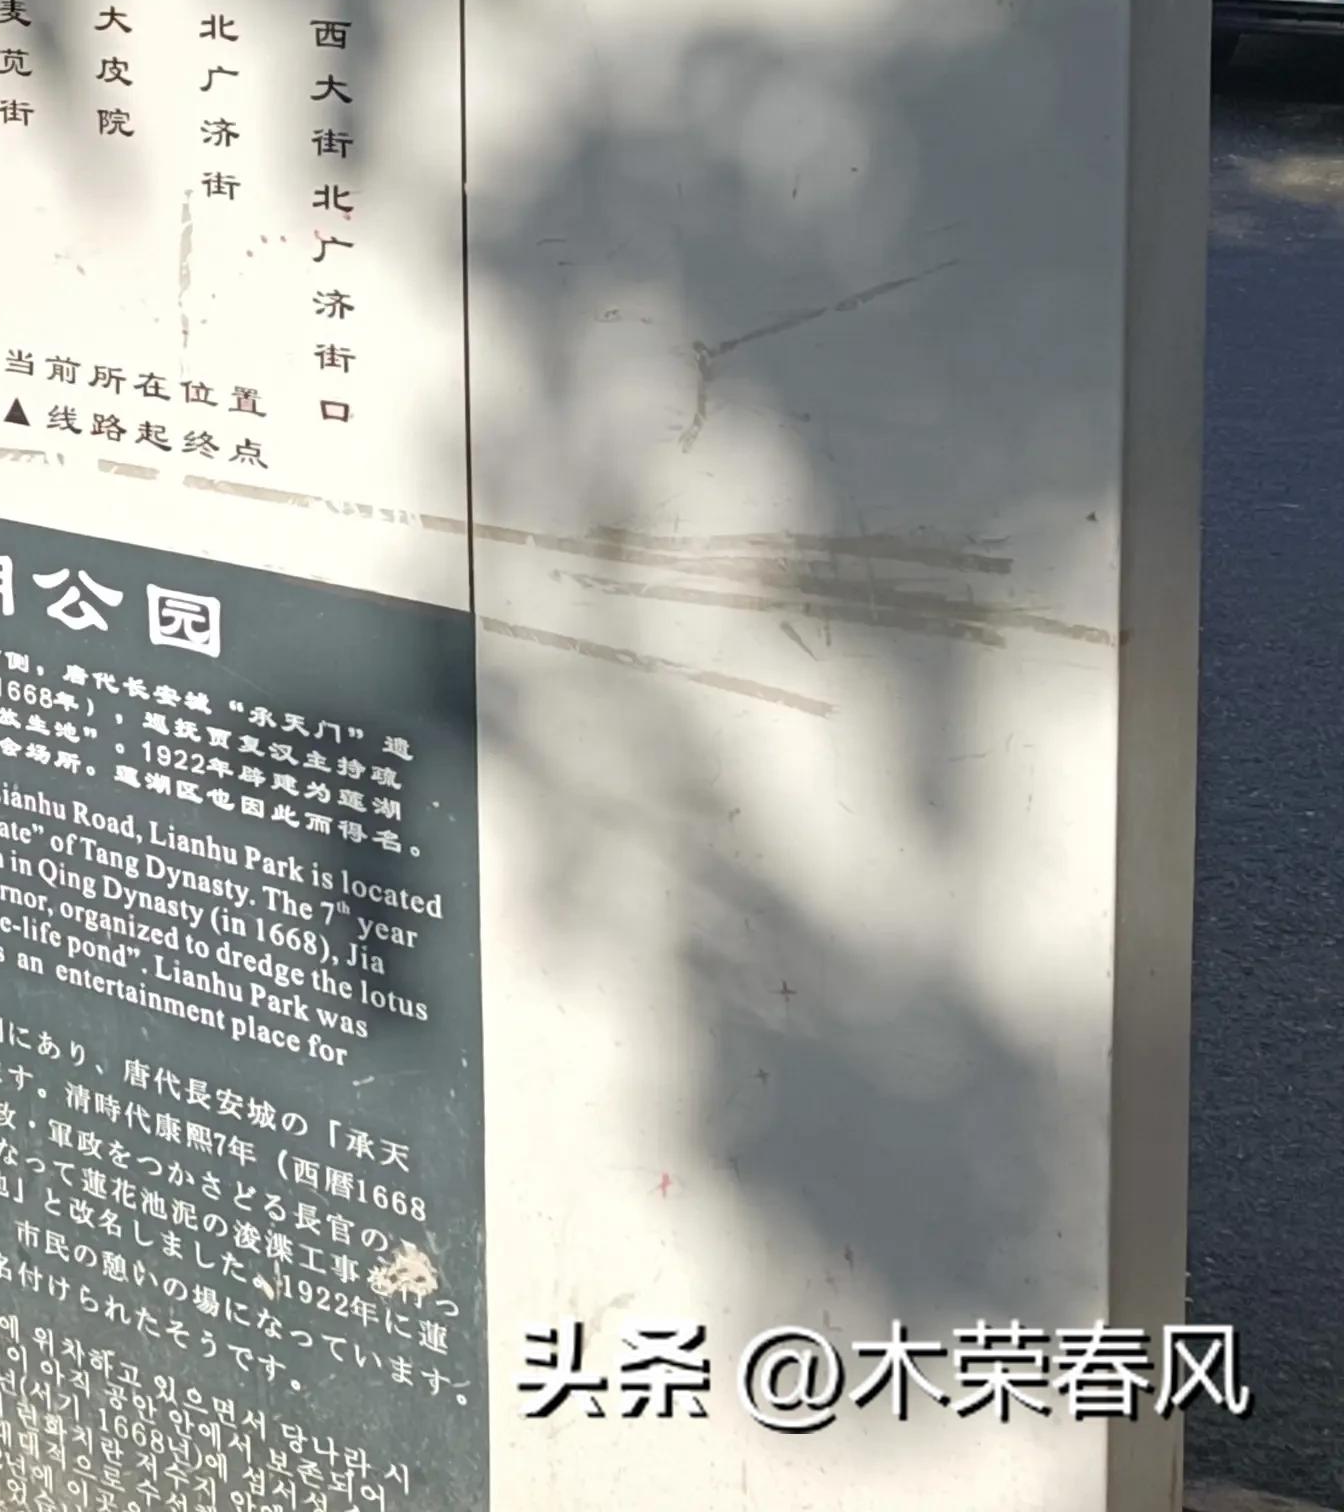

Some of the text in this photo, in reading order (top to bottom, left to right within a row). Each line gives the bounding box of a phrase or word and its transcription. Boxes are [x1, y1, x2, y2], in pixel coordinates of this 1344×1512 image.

[93, 4, 135, 138] 大皮院
[198, 13, 241, 201] 北广济街
[308, 18, 357, 423] 西大街北广济街口
[4, 348, 267, 418] 当前所在位置
[45, 403, 269, 469] 线路起终点
[9, 848, 33, 877] in
[36, 857, 97, 900] Qing
[100, 873, 205, 929] Dynasty
[209, 904, 247, 937] (in
[254, 916, 339, 966] 1668),
[345, 941, 385, 975] Jia
[48, 831, 78, 856] of
[78, 835, 140, 879] Tang
[144, 852, 256, 909] Dynasty.
[260, 884, 313, 921] The
[318, 899, 351, 926] 7th
[356, 915, 418, 948] year
[70, 799, 143, 845] Road,
[147, 819, 238, 866] Lianhu
[243, 843, 305, 883] Park
[310, 860, 334, 890] is
[340, 868, 443, 919] located
[16, 951, 44, 975] an
[54, 963, 226, 1031] entertainment
[229, 1013, 301, 1053] place
[306, 1032, 348, 1066] for
[58, 900, 180, 951] organized
[183, 932, 210, 959] to
[214, 939, 305, 988] dredge
[309, 967, 353, 1000] the
[359, 978, 428, 1021] lotus
[66, 934, 148, 975] pond”.
[153, 953, 244, 1003] Lianhu
[248, 981, 310, 1022] Park
[314, 1006, 369, 1038] was
